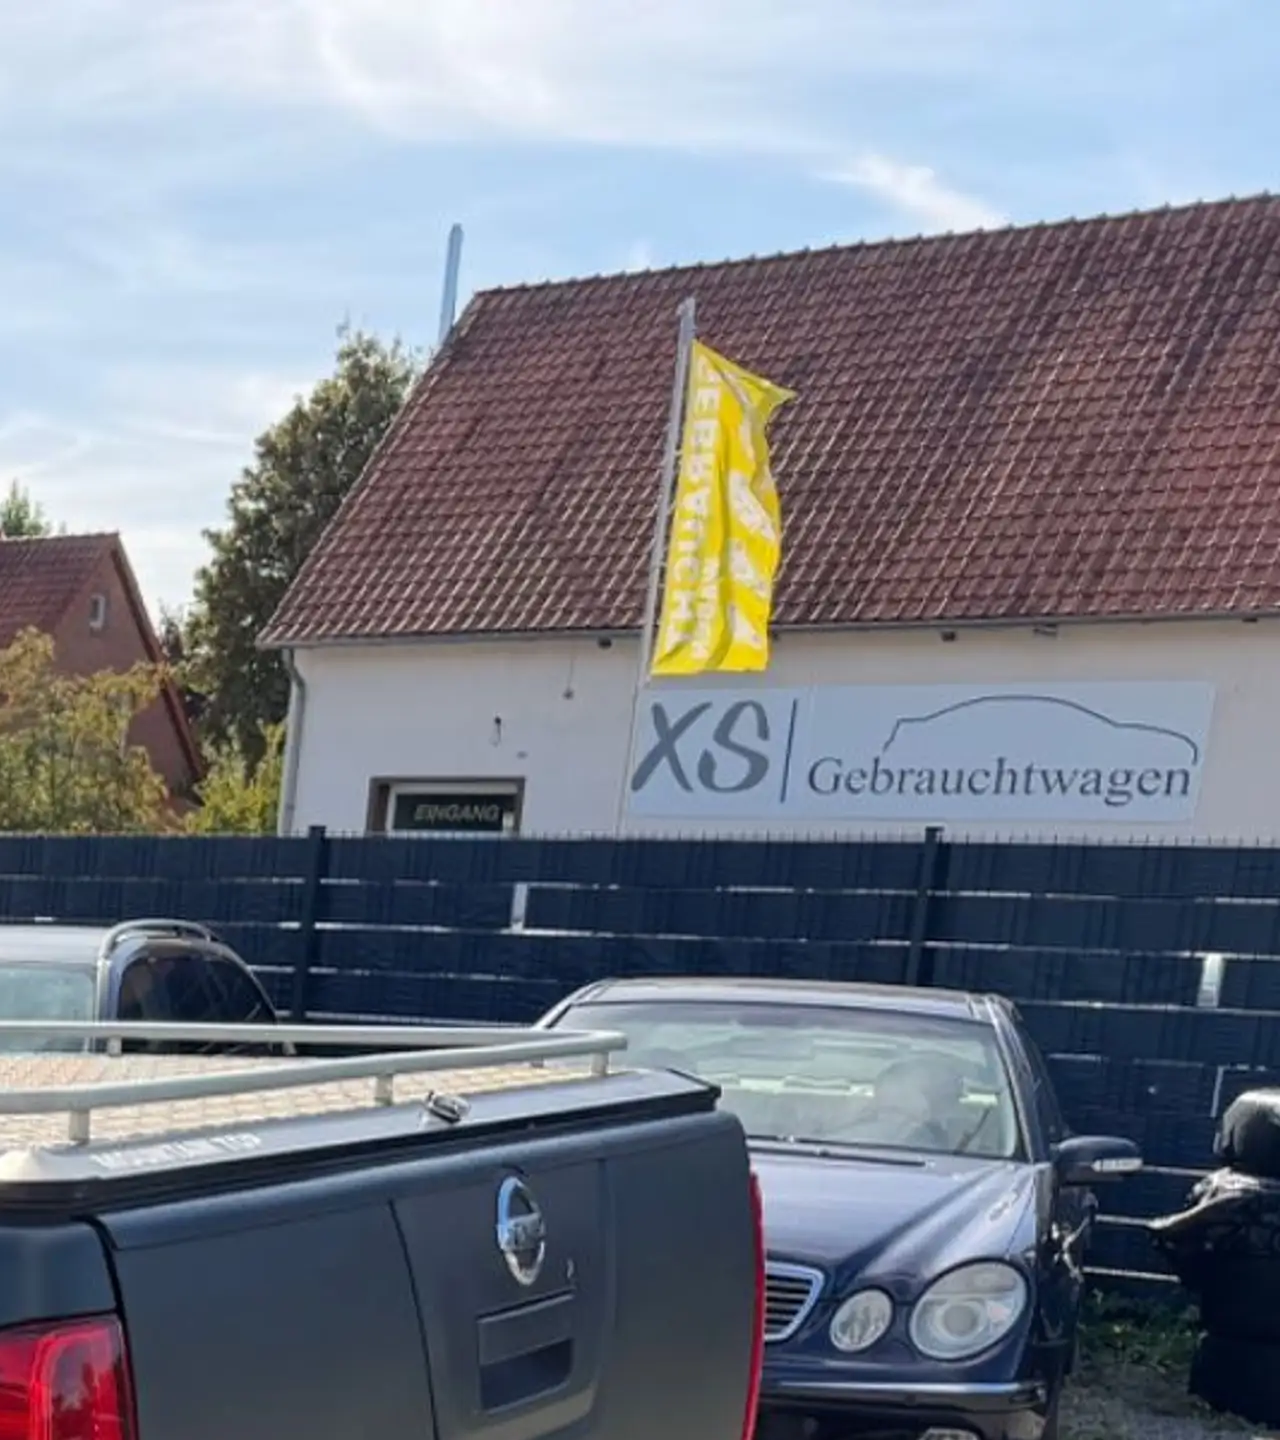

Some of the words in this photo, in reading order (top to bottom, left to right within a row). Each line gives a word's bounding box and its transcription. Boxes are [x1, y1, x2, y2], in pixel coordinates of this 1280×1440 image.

[631, 699, 771, 793] XS
[807, 756, 1192, 806] Gebrauchtwagen
[413, 803, 499, 824] EINGANG
